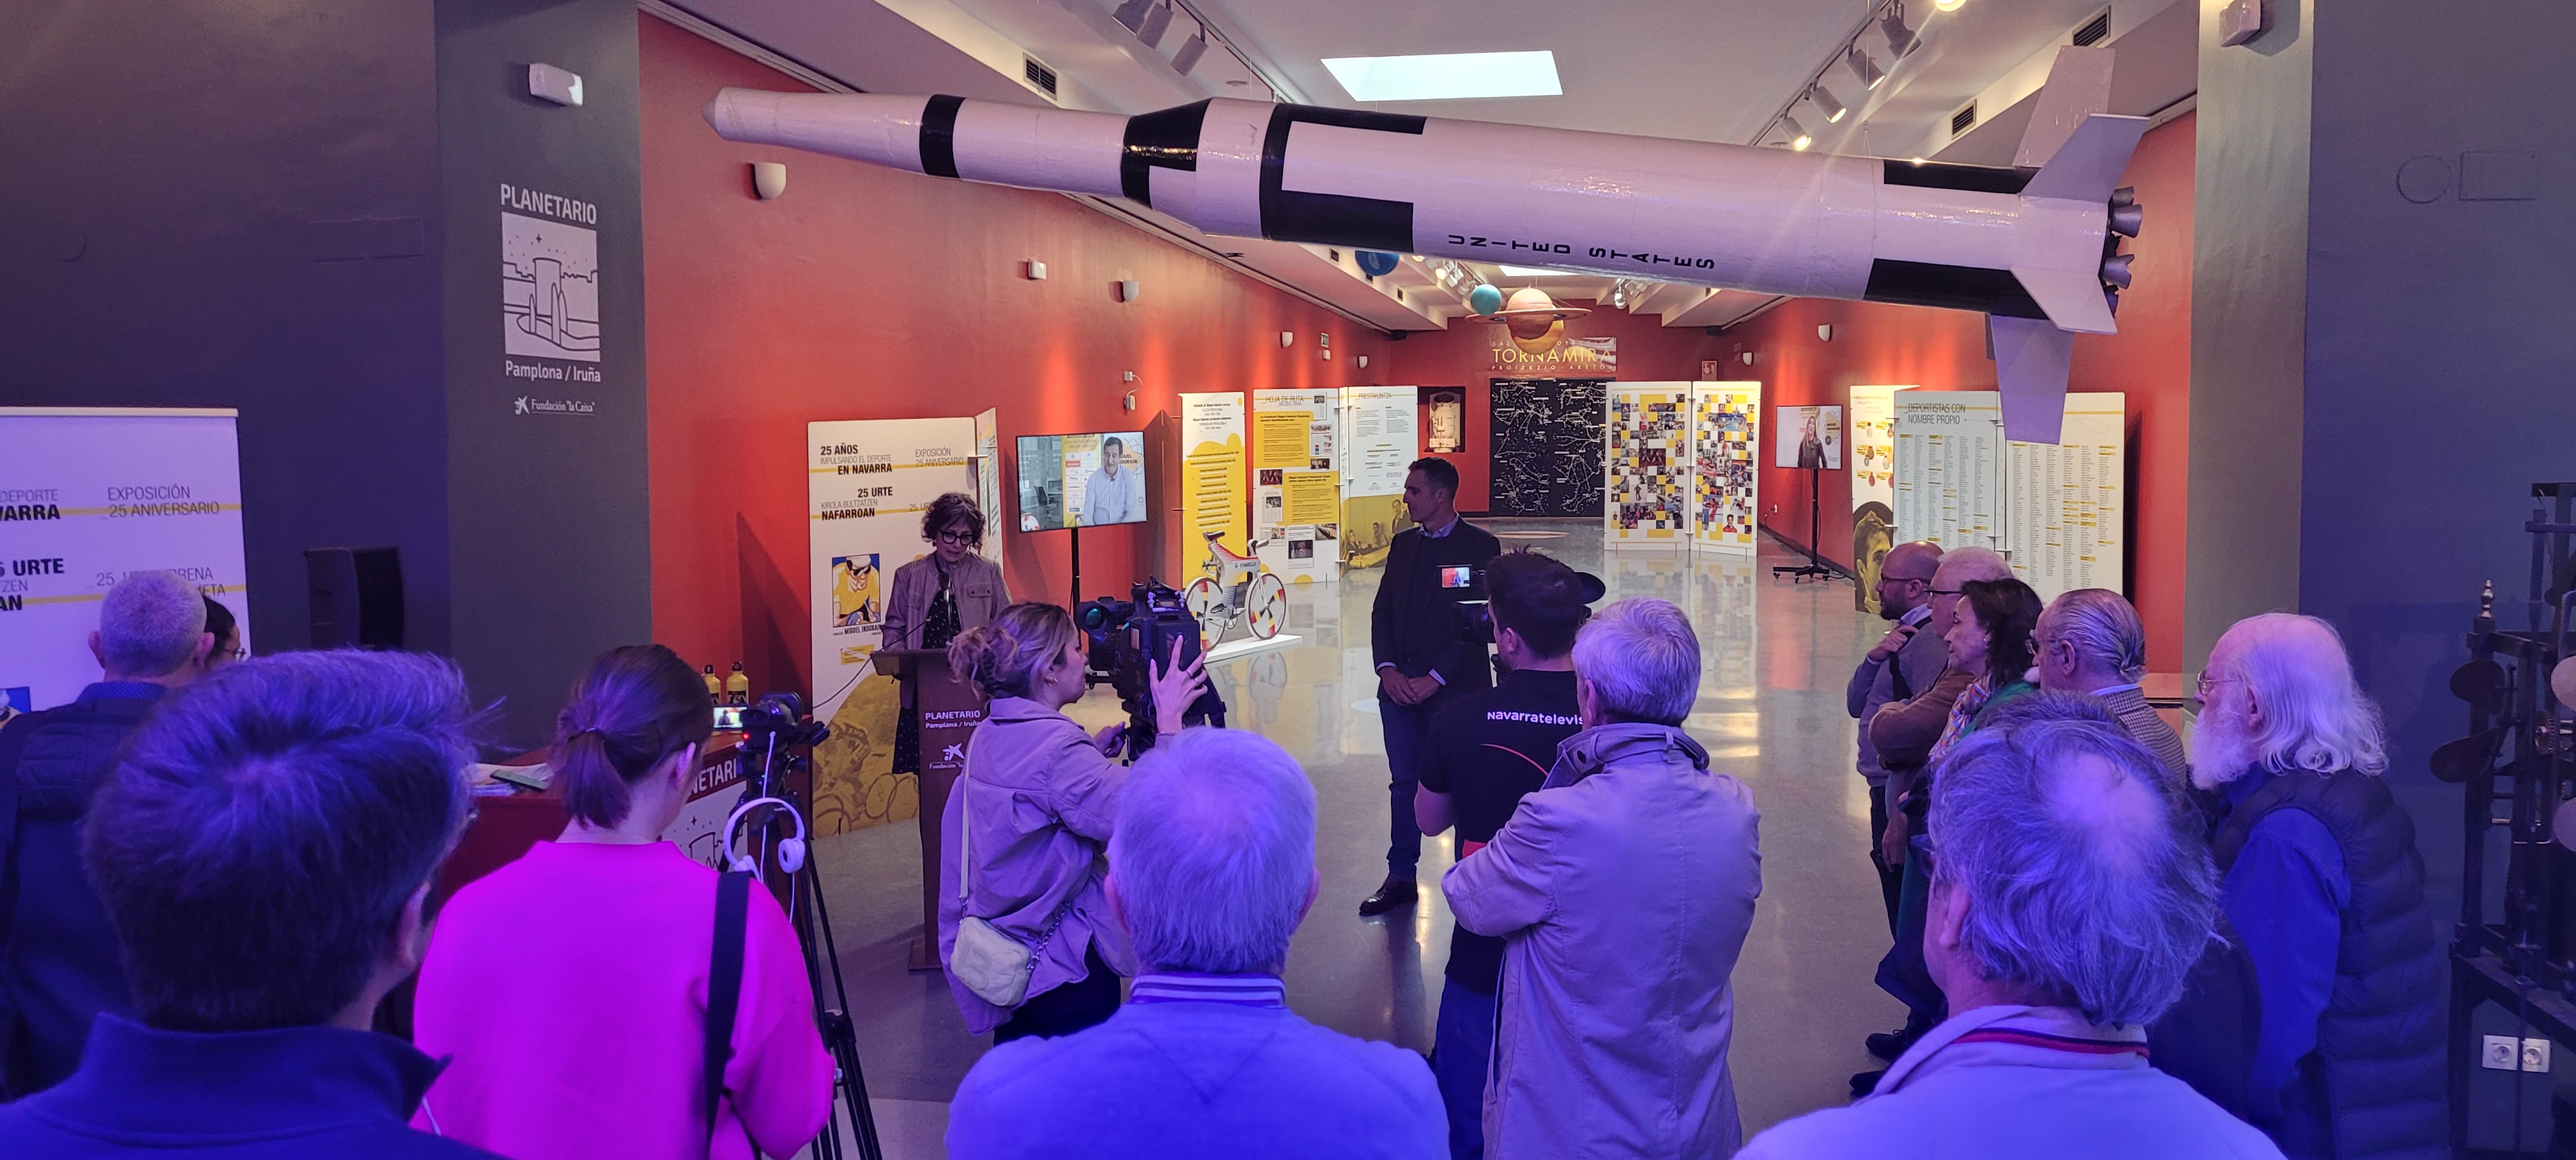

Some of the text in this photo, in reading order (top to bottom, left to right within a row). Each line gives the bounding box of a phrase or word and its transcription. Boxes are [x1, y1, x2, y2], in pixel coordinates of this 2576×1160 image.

[500, 183, 597, 225] PLANETARIO
[1448, 234, 1715, 270] UNITED STATES
[1492, 347, 1613, 363] TORNAMIRA
[505, 360, 601, 383] Pamplona / Iruña
[531, 399, 566, 411] Fundación
[1908, 403, 1966, 413] DEPORTISTAS CON
[1908, 415, 1960, 425] NOMBRE PROPIO
[820, 442, 858, 456] 25 AÑOS
[916, 447, 951, 457] EXPOSICIÓN
[820, 456, 857, 464] IMPULSANDO
[916, 457, 964, 468] 25 ANIVERSARIO
[838, 463, 893, 475] EN NAVARRA
[0, 489, 58, 503] DEPORTE
[107, 483, 191, 501] EXPOSICIÓN
[857, 487, 893, 498] 25 URTE
[109, 501, 220, 518] 25 ANIVERSARIO
[821, 499, 878, 509] KIROLA BULTZATZEN
[822, 508, 875, 521] NAFARROAN
[13, 558, 65, 576] URTE
[96, 572, 115, 587] 25
[924, 710, 981, 721] PLANETARIO
